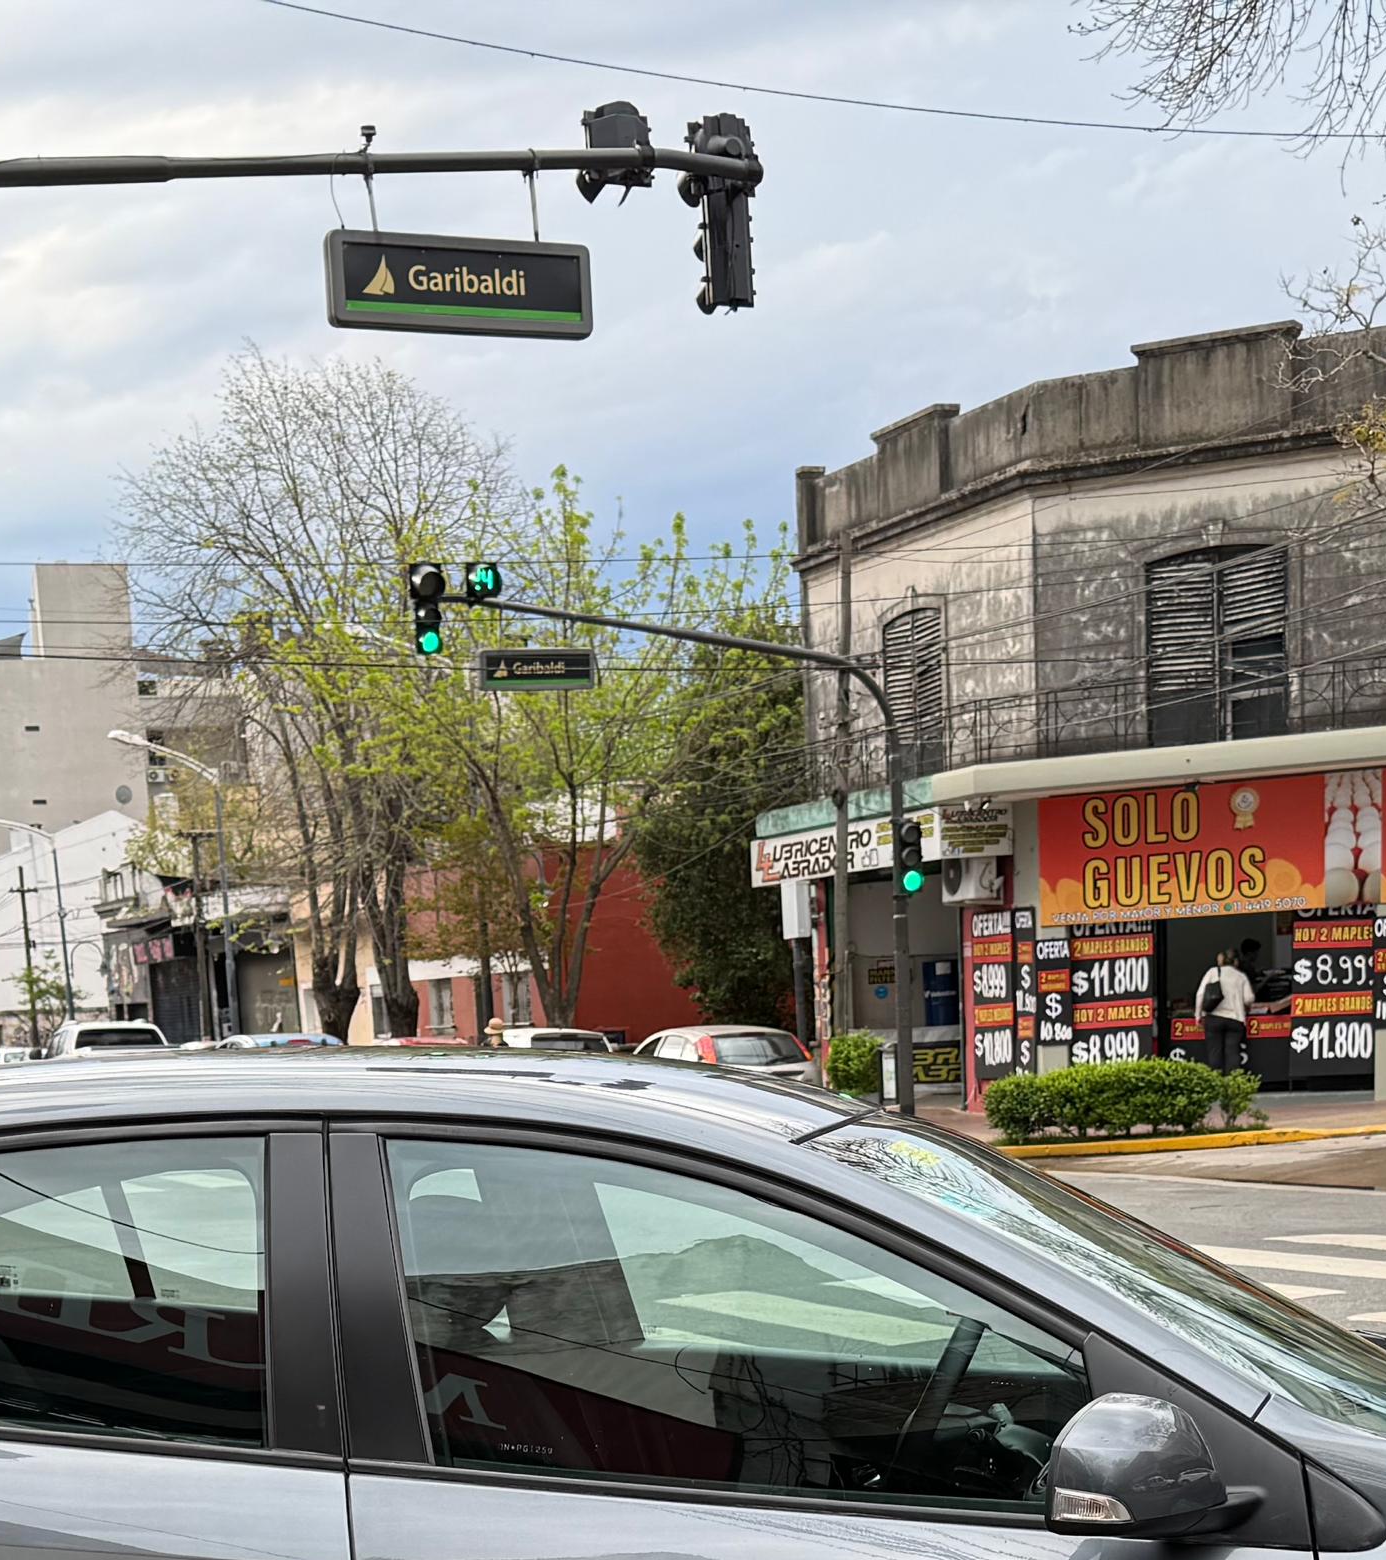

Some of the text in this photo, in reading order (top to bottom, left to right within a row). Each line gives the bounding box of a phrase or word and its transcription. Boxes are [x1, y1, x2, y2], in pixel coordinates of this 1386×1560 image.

[407, 264, 526, 296] Garibaldi
[512, 661, 565, 676] Garibaldi
[1083, 790, 1201, 850] SOLO
[756, 829, 872, 872] LUBRICENRO
[1083, 845, 1267, 910] GUEVOS
[972, 910, 1012, 938] OFERTA!!!
[1052, 911, 1089, 924] VENTA
[1093, 911, 1117, 921] POR
[1120, 908, 1161, 920] MAYOR
[1164, 906, 1171, 917] Y
[1176, 903, 1219, 917] MENOR
[1295, 927, 1317, 942] HOY
[1319, 927, 1328, 941] 2
[1036, 939, 1070, 960] OFERTA
[1074, 937, 1149, 958] 2 MAPLES GRANDES
[1377, 951, 1384, 962] 2
[1020, 964, 1031, 990] $
[1045, 993, 1062, 1019] $
[1074, 1004, 1150, 1023] HOY 2 MAPLES
[1295, 997, 1303, 1015] 2
[1303, 997, 1337, 1013] MAPLES
[1175, 1022, 1183, 1036] 2
[1250, 1020, 1258, 1034] 2
[1020, 1039, 1030, 1065] $
